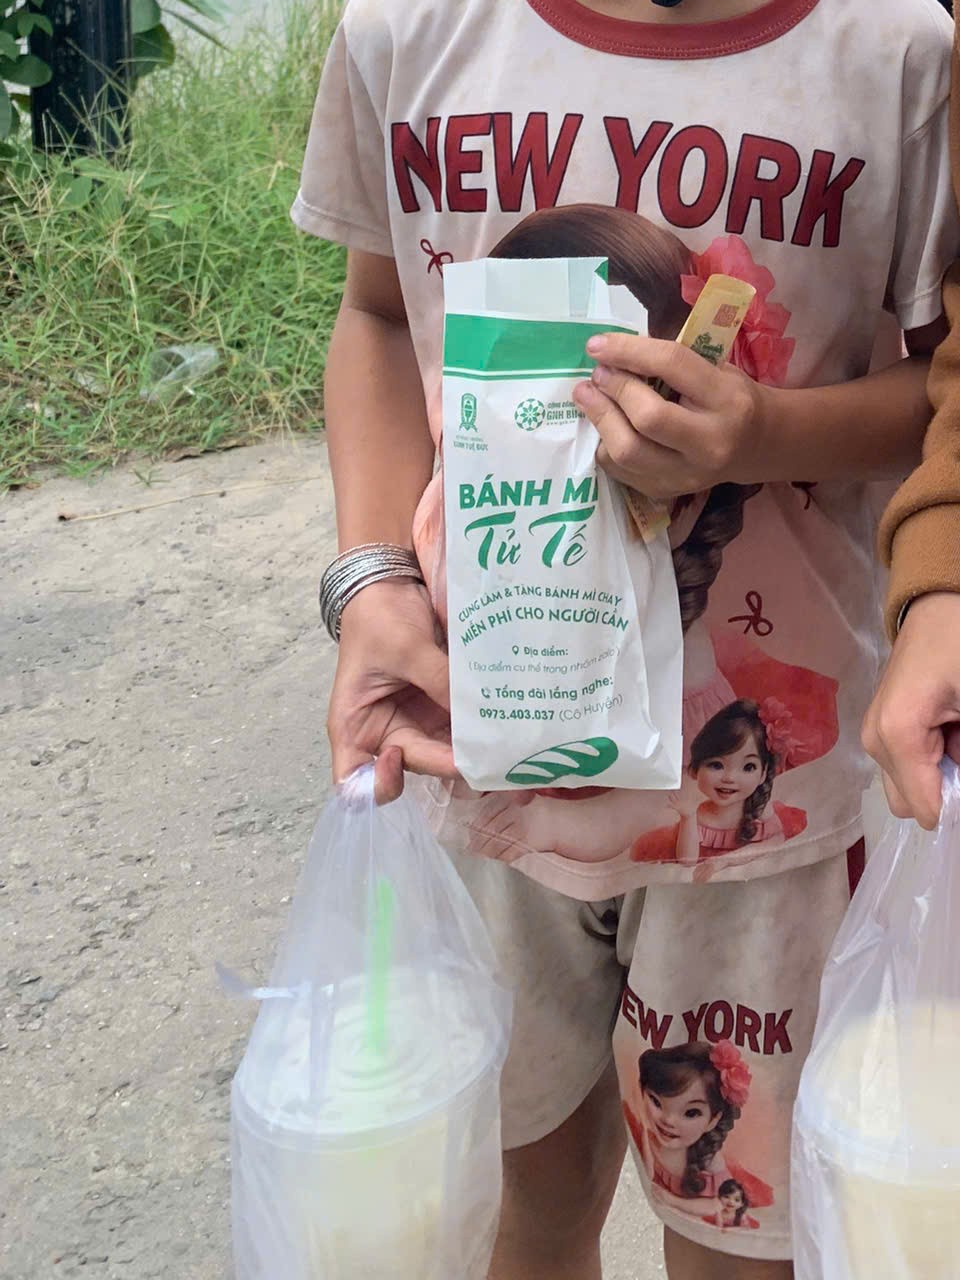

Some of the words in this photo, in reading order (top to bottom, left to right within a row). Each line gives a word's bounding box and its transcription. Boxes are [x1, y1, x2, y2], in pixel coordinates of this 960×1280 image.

[391, 111, 584, 214] NEW
[602, 115, 866, 249] YORK
[459, 473, 553, 510] BÁNH
[464, 510, 521, 570] Tử
[528, 505, 596, 569] Tế
[504, 587, 513, 598] &
[598, 590, 623, 607] CHAY
[515, 606, 545, 620] CHO
[582, 676, 614, 696] nghe:
[479, 707, 555, 720] 0973.403.037
[622, 984, 673, 1050] EW
[682, 1000, 793, 1055] YORK
